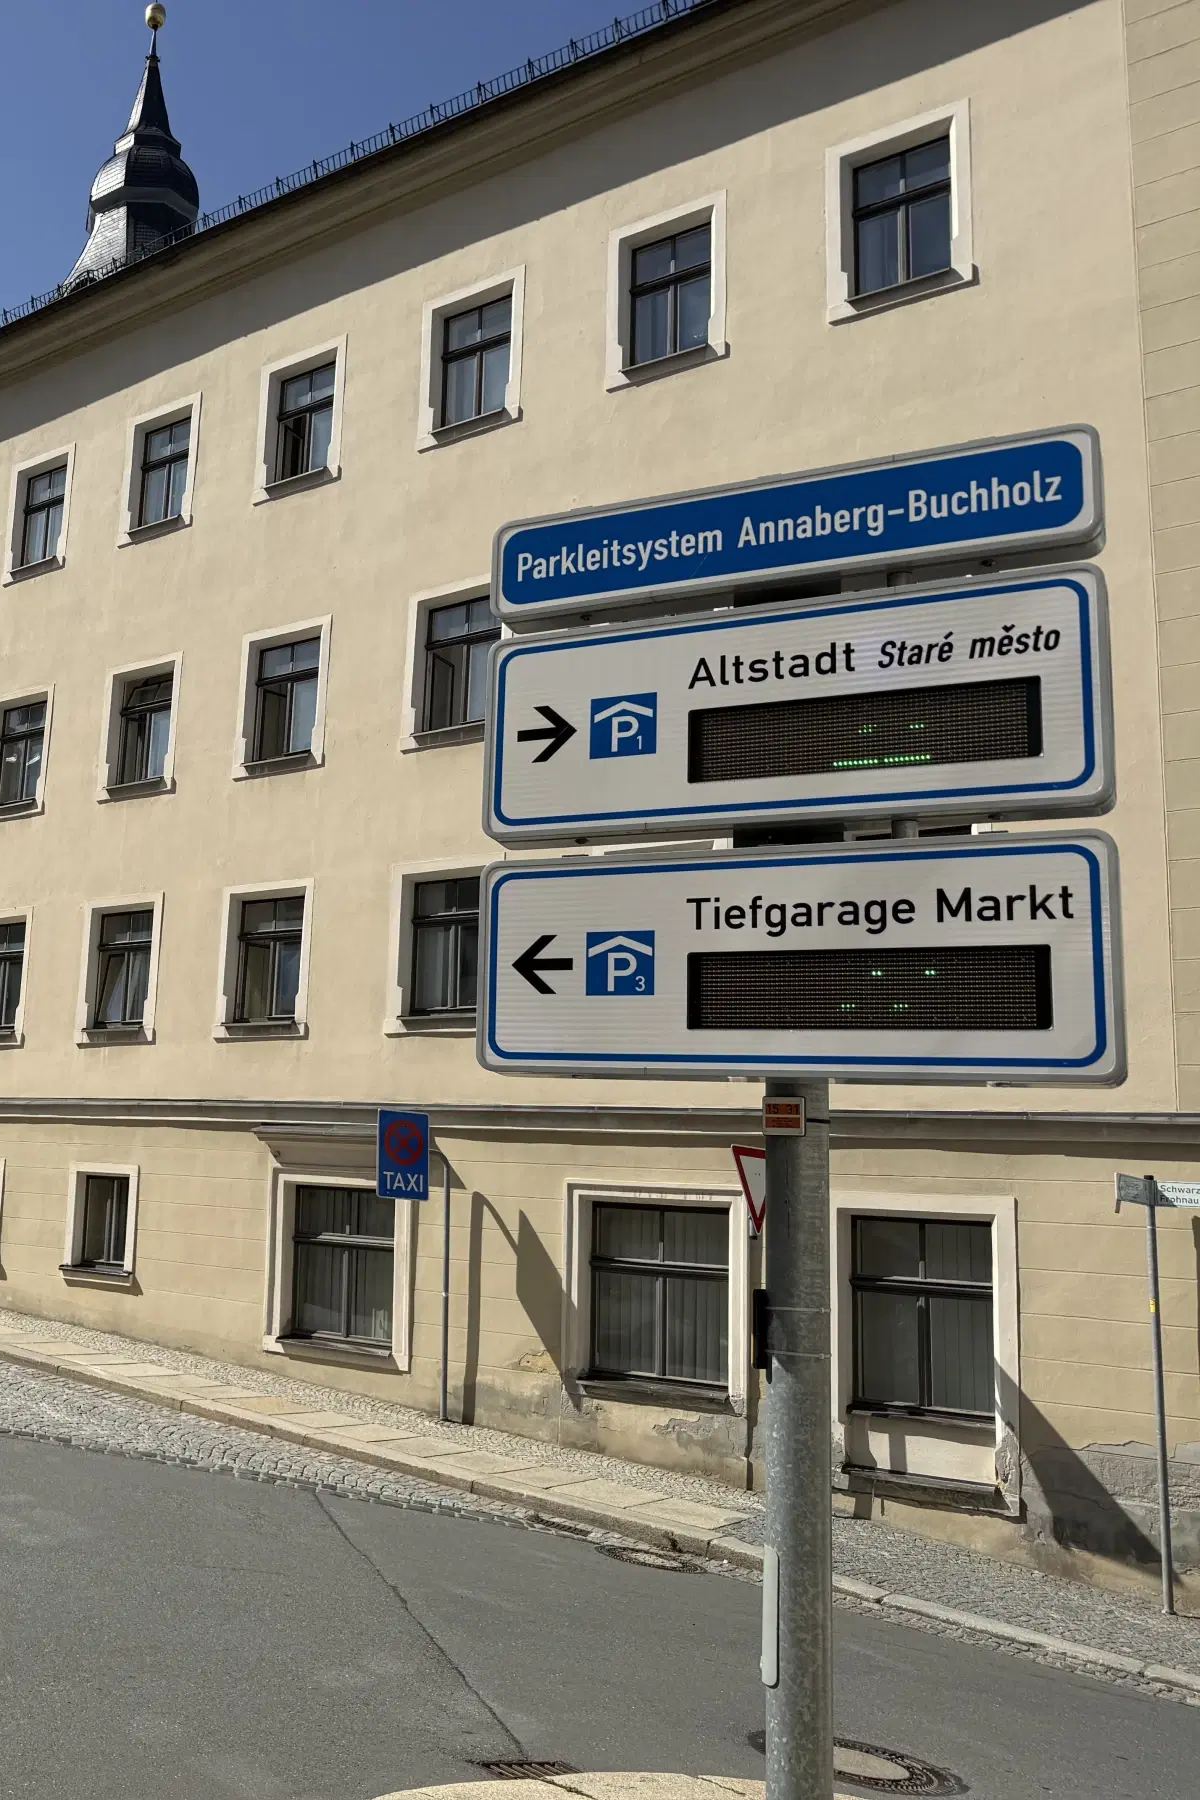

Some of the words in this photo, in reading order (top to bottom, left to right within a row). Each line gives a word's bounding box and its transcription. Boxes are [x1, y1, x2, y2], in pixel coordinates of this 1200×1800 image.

[517, 529, 723, 582] Parkleitsystem
[737, 470, 1062, 548] Annaberg-Buchholz
[687, 642, 856, 690] Altstadt
[877, 630, 954, 669] Staré
[968, 623, 1061, 660] město
[686, 895, 916, 938] Tiefgarage
[936, 884, 1074, 923] Markt
[383, 1171, 423, 1193] TAXI
[1160, 1194, 1199, 1205] Frohnau
